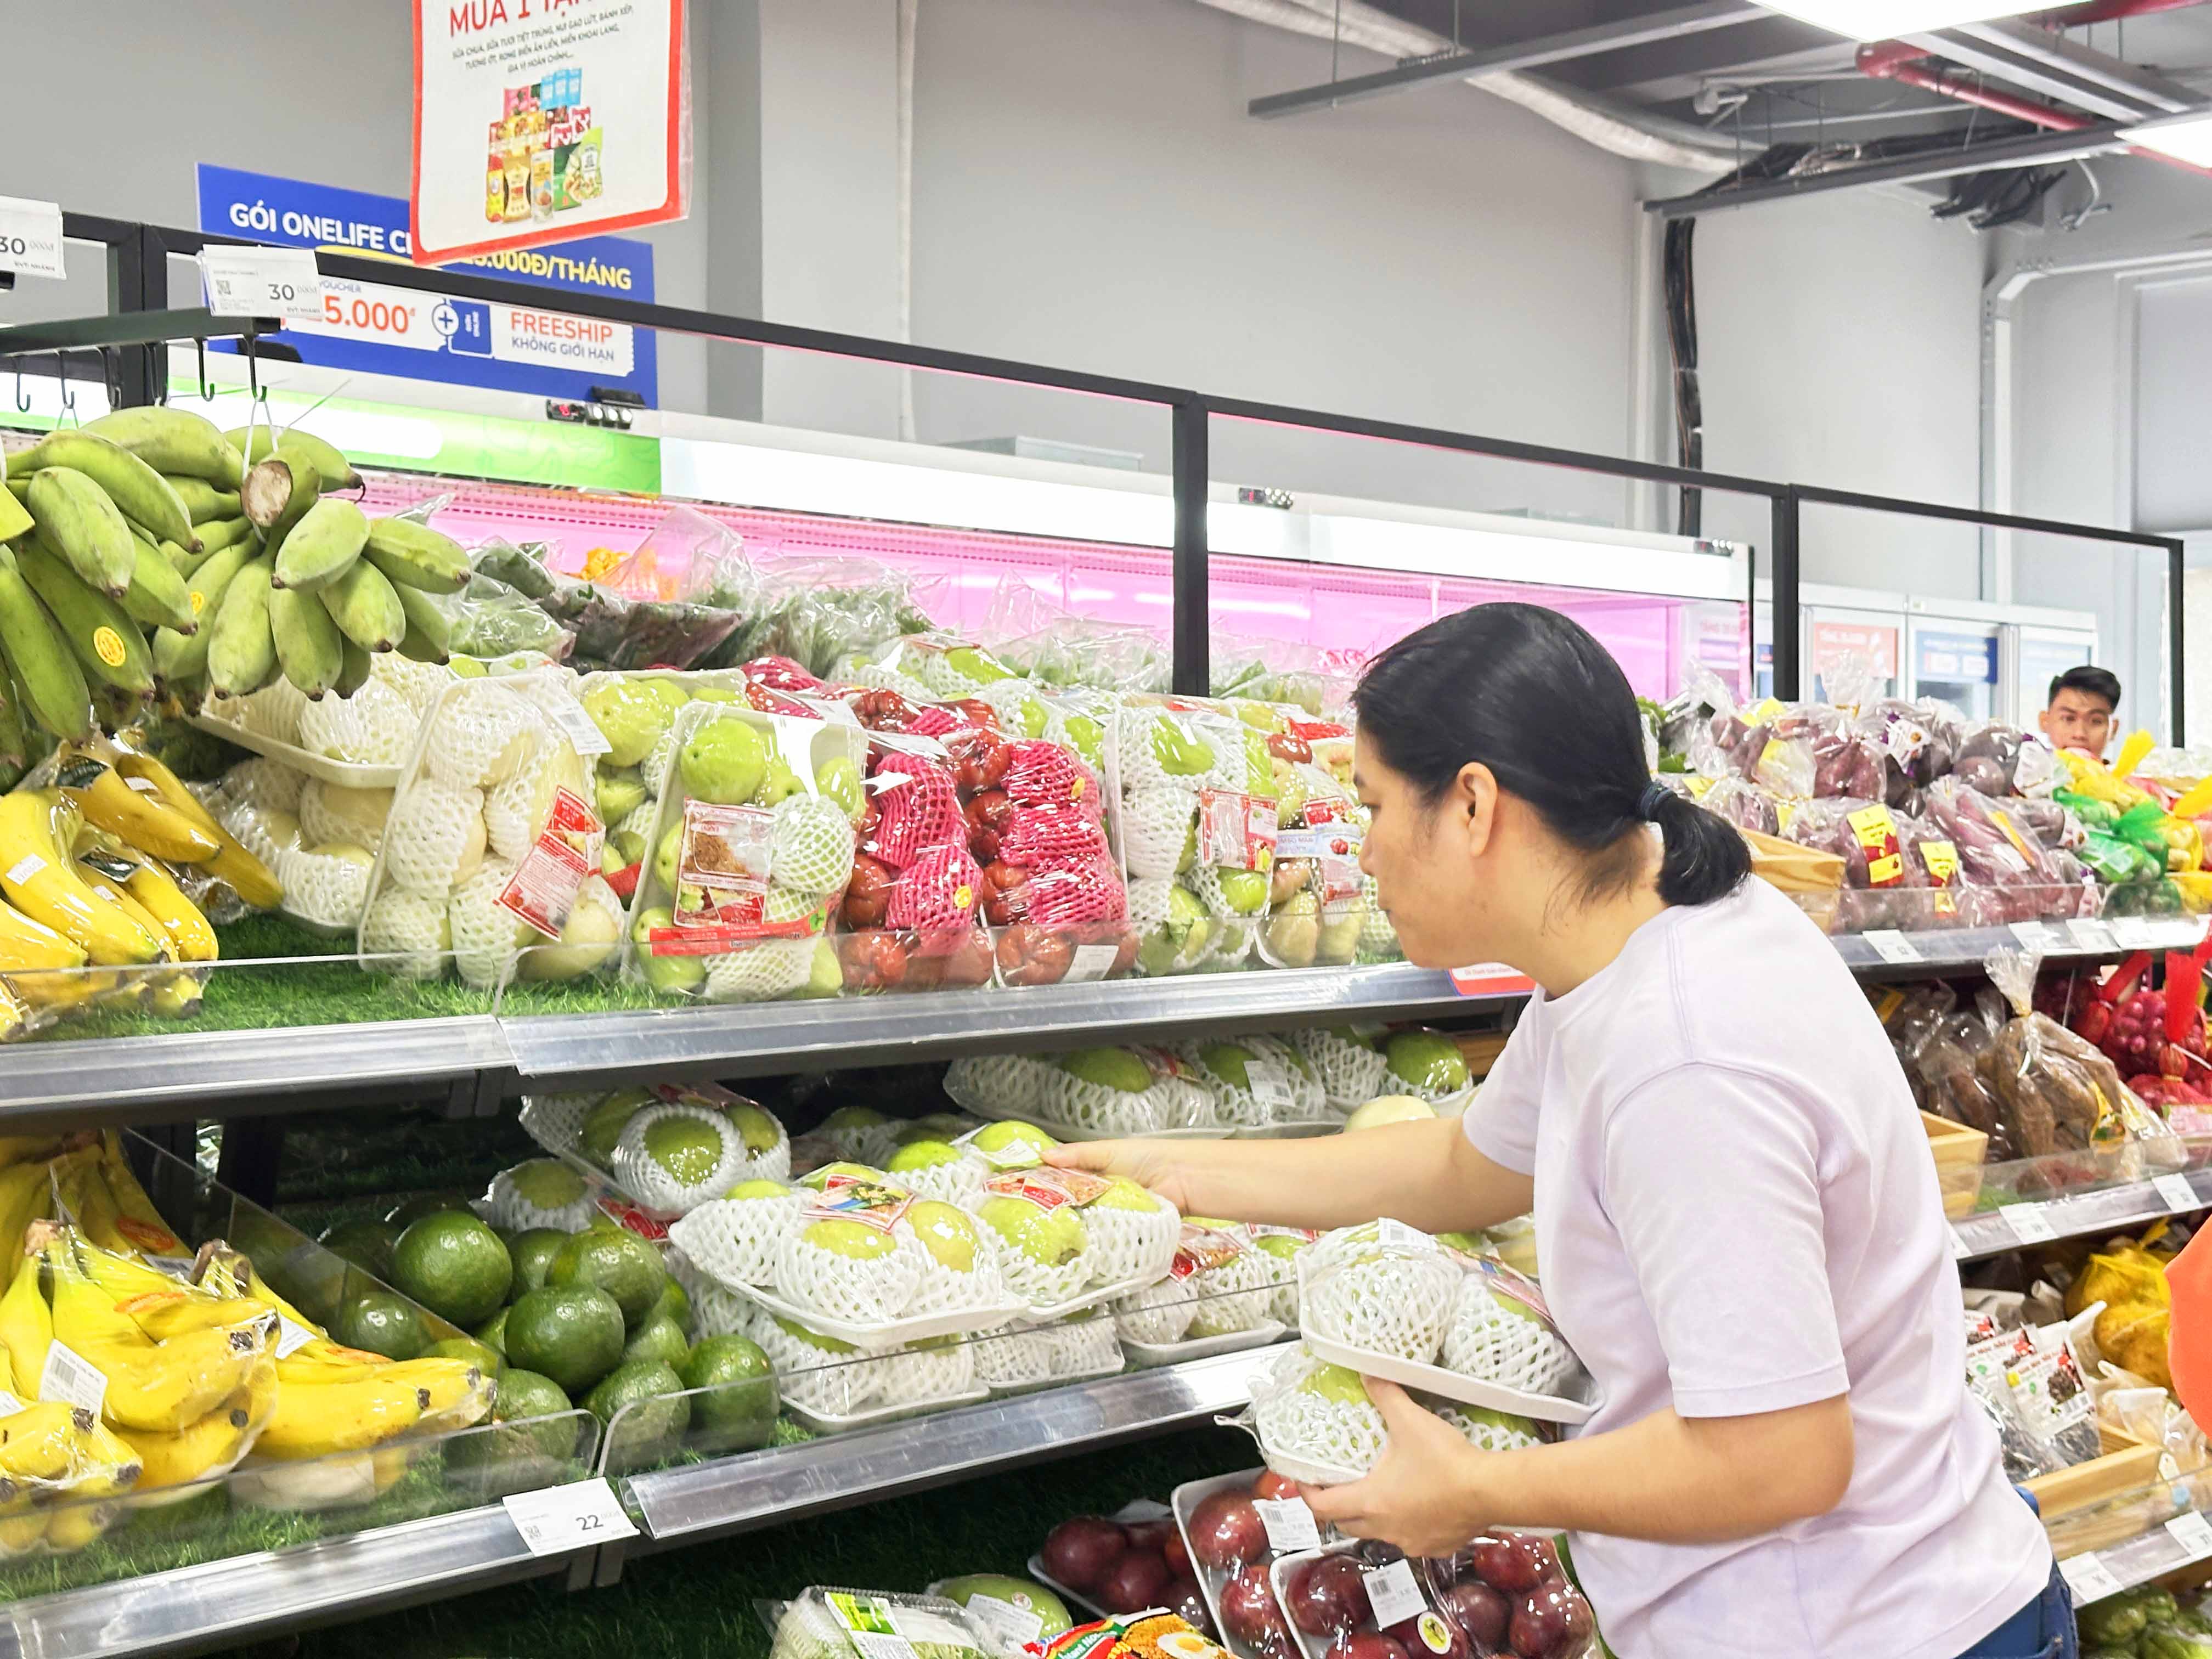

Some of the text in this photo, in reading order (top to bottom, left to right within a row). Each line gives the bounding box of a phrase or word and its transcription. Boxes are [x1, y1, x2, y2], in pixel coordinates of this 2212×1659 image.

[450, 0, 507, 37] MUA
[229, 199, 277, 233] GÓI
[282, 211, 385, 250] ONELIFE
[268, 284, 295, 301] 30
[510, 311, 613, 344] FREESHIP
[511, 336, 614, 364] KHÔNG GIỚI HẠN
[575, 1514, 604, 1531] 22
